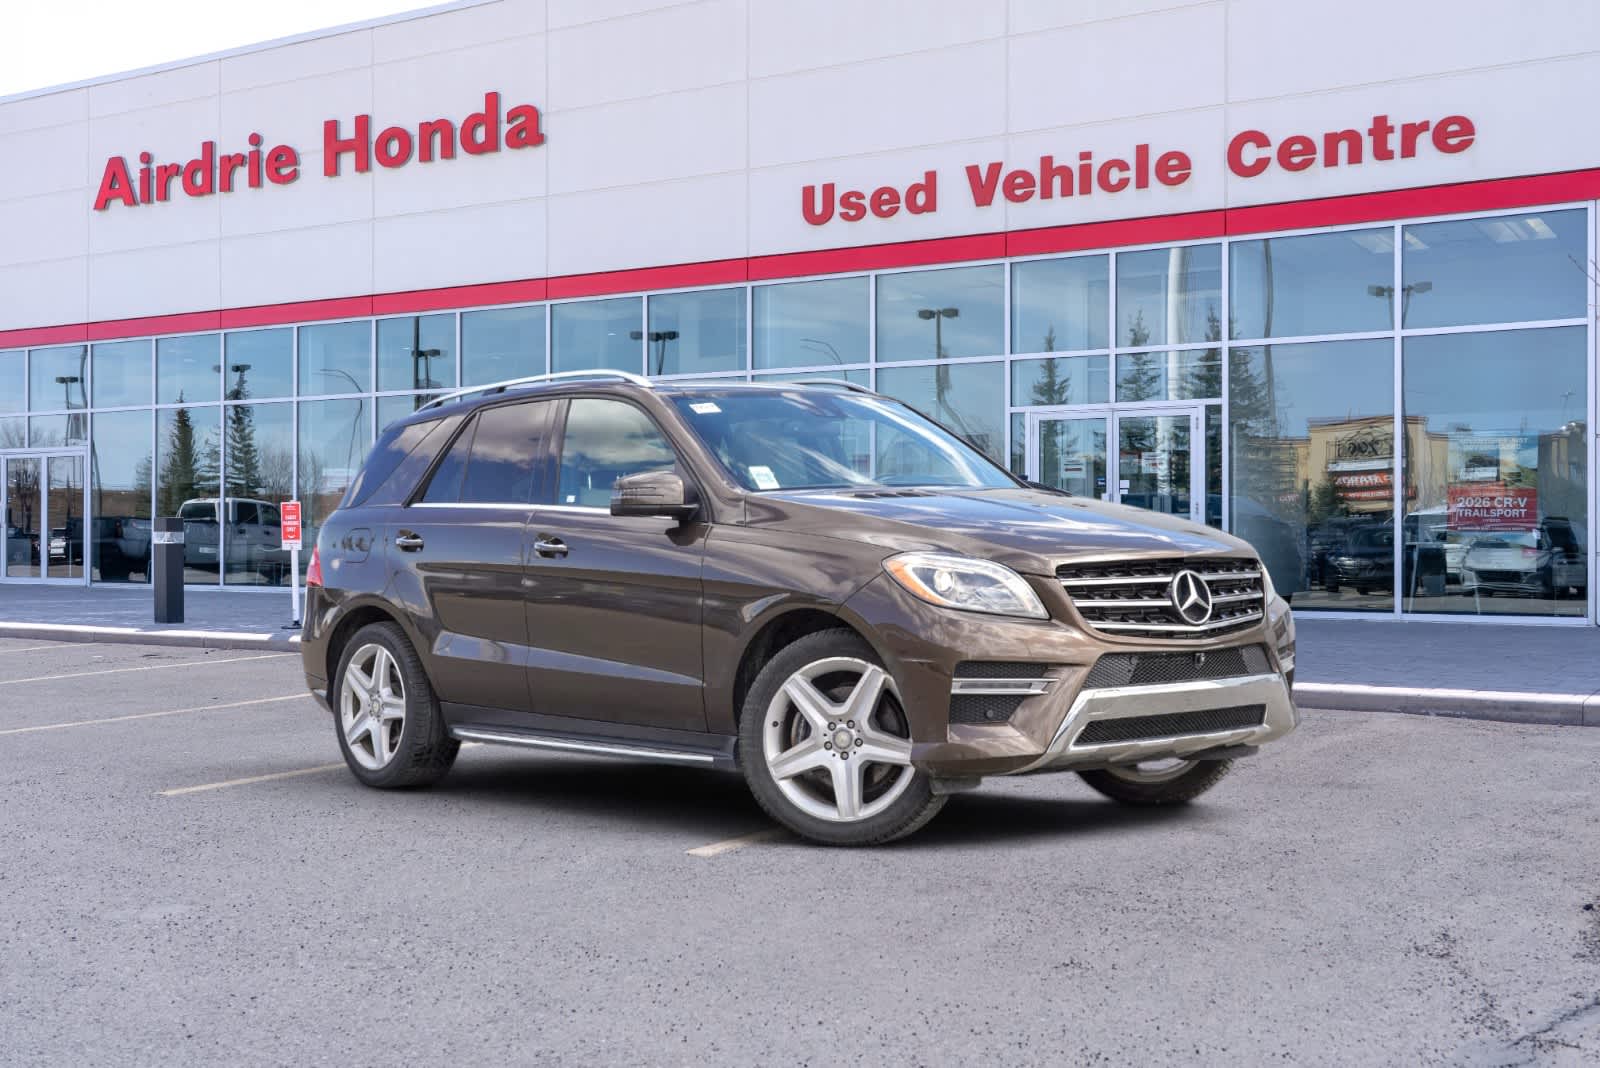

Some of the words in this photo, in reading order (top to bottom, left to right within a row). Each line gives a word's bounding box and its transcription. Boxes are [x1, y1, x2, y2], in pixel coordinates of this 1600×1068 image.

[94, 133, 298, 211] Airdrie
[323, 92, 546, 177] Honda
[802, 171, 937, 226] Used
[966, 143, 1191, 207] Vehicle
[1228, 115, 1475, 178] Centre
[1456, 496, 1491, 508] 2026
[1494, 496, 1528, 508] CR-V
[1458, 508, 1528, 518] TRAILSPORT
